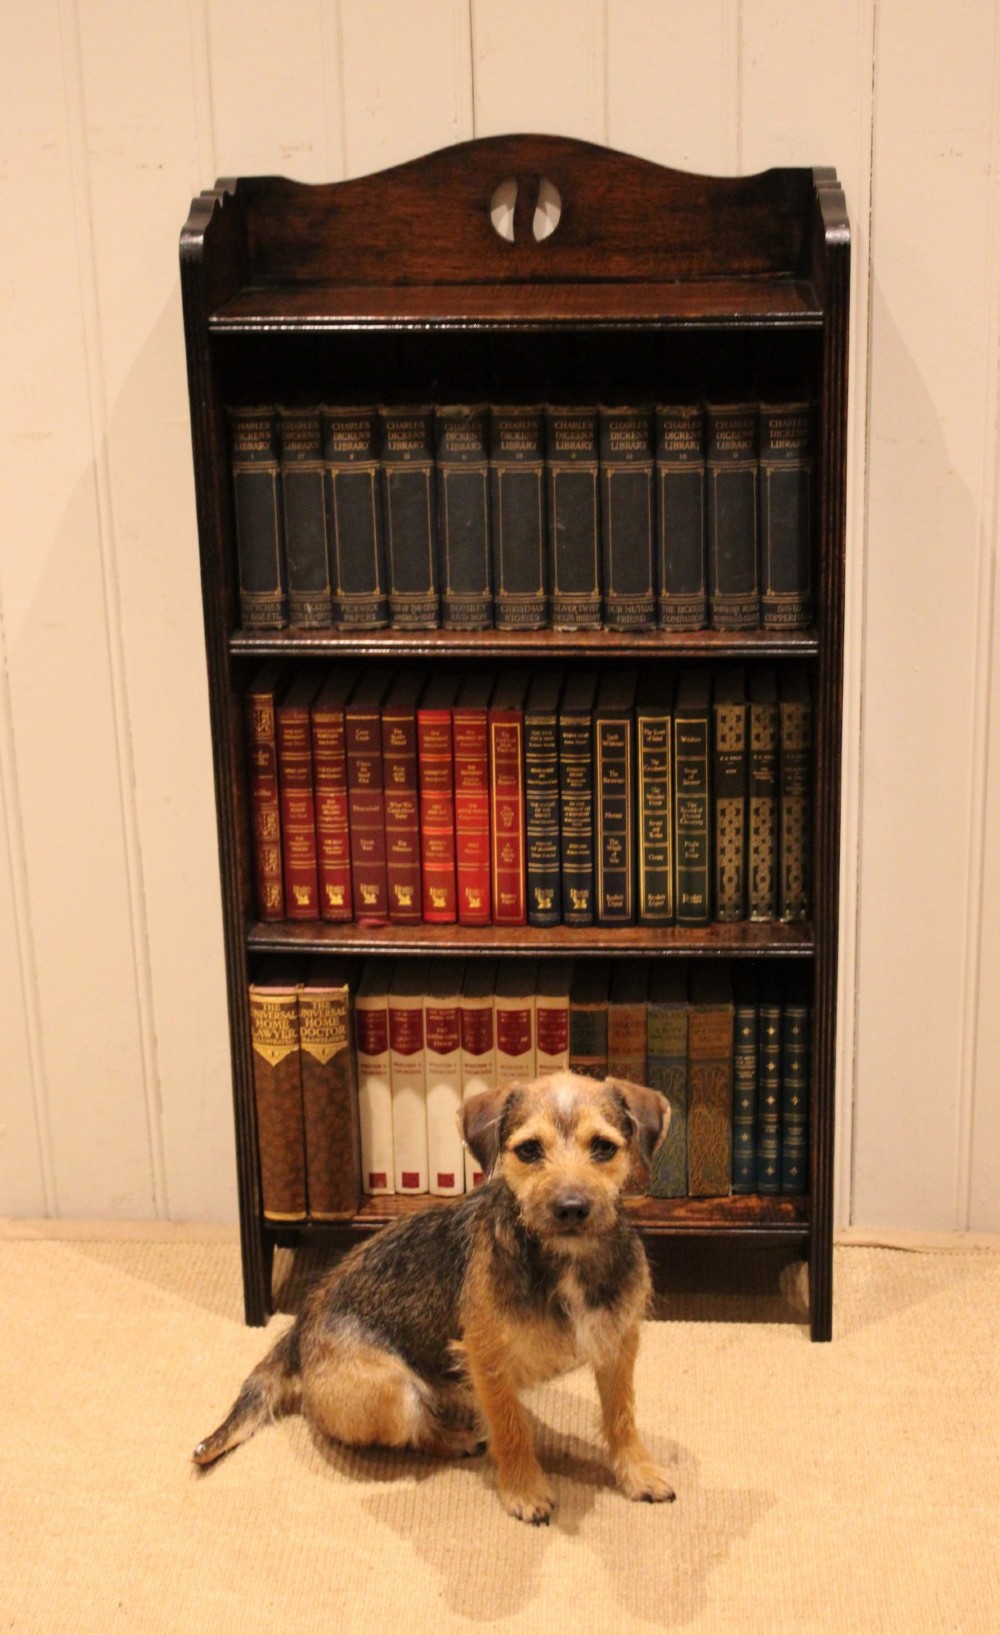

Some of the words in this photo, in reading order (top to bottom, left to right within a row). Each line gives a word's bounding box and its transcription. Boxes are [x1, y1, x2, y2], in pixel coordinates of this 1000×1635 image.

[332, 421, 370, 430] CHARLES
[386, 421, 425, 430] CHARLES
[500, 421, 538, 430] CHARLES
[554, 421, 593, 430] CHARLES
[609, 421, 648, 430] CHARLES
[664, 421, 701, 430] CHARLES
[333, 432, 371, 441] DICKENS
[387, 432, 425, 441] DICKENS
[500, 432, 538, 440] DICKENS
[555, 431, 594, 440] DICKENS
[610, 432, 648, 441] DICKENS
[664, 432, 701, 440] DICKENS
[334, 442, 369, 451] LIBRARY
[388, 442, 424, 451] LIBRARY
[501, 442, 537, 451] LIBRARY
[556, 441, 592, 451] LIBRARY
[611, 442, 647, 451] LIBRARY
[664, 442, 700, 451] LIBRARY
[256, 1019, 290, 1028] HOME
[304, 1018, 339, 1027] HOME
[252, 1028, 297, 1039] LAWYER
[299, 1026, 346, 1037] DOCTOR
